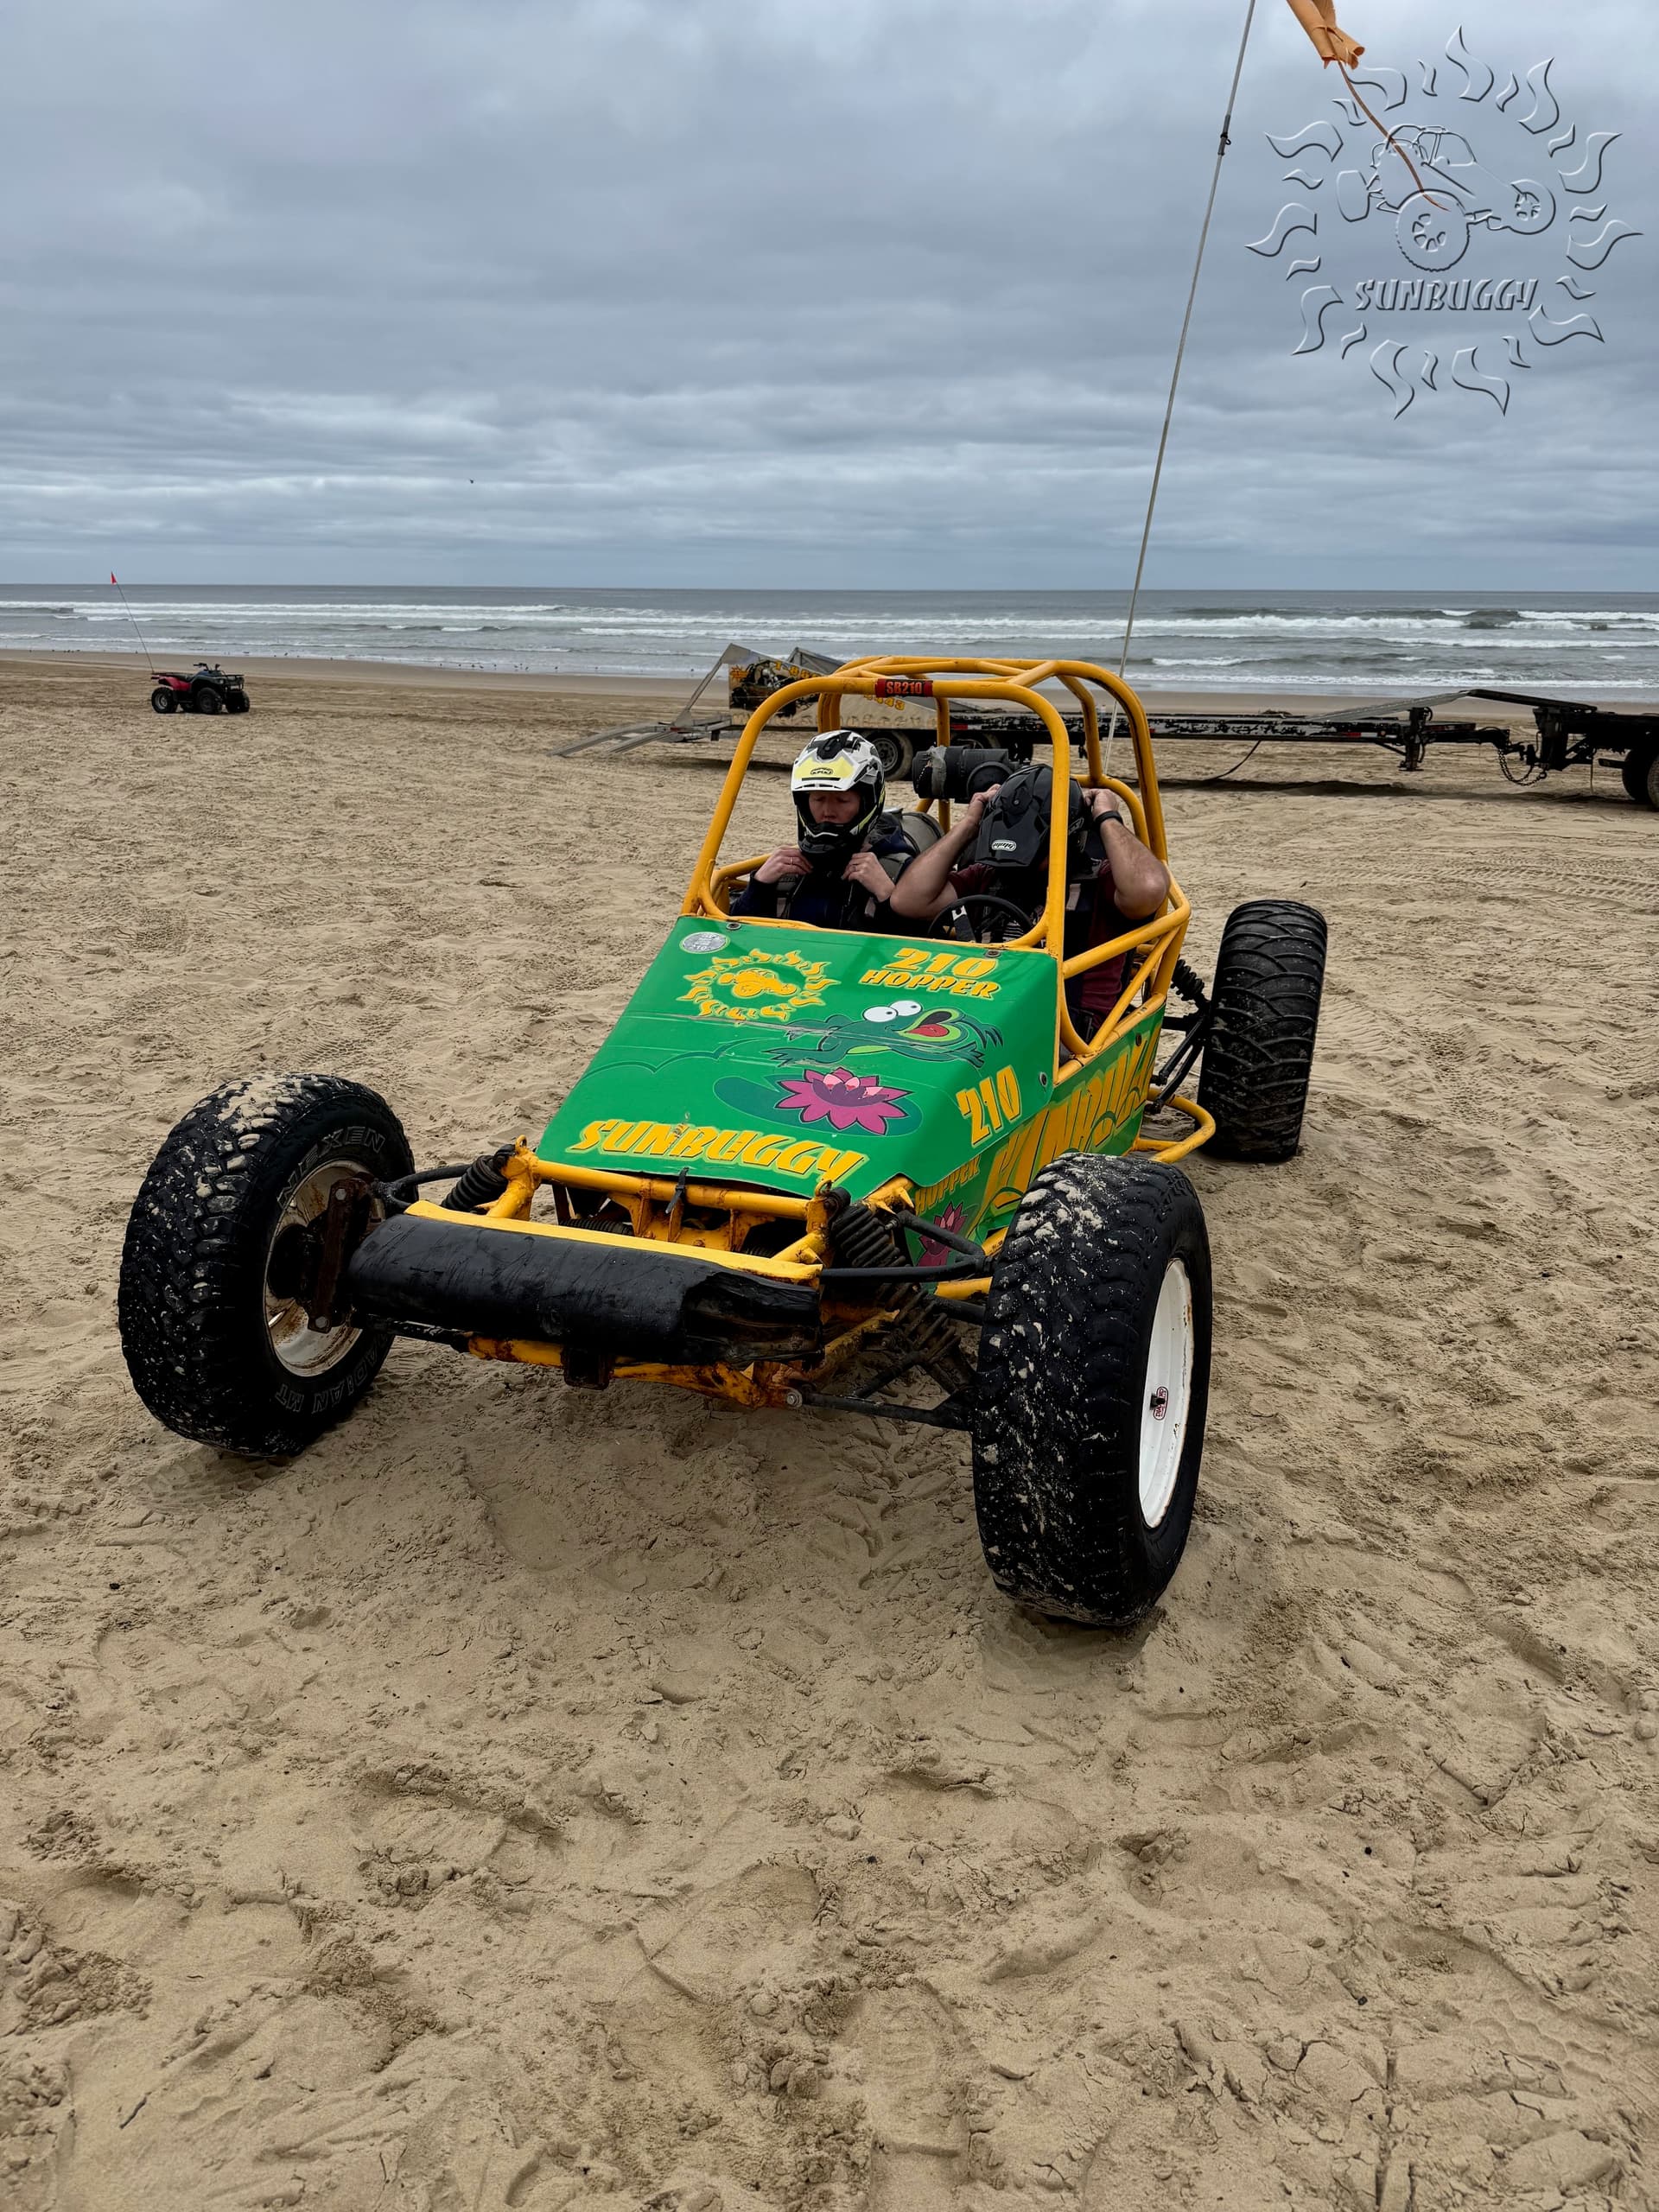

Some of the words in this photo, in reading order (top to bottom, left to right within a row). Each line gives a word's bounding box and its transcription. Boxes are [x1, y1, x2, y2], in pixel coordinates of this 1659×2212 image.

[886, 681, 923, 695] SB210
[860, 969, 1000, 1000] HOPPER
[883, 947, 998, 978] 210
[957, 1065, 1020, 1147] 210
[276, 1126, 386, 1210] NEXEN
[565, 1119, 867, 1183] SUNBUGGY
[914, 1154, 981, 1217] HOPPER
[274, 1382, 304, 1413] MT
